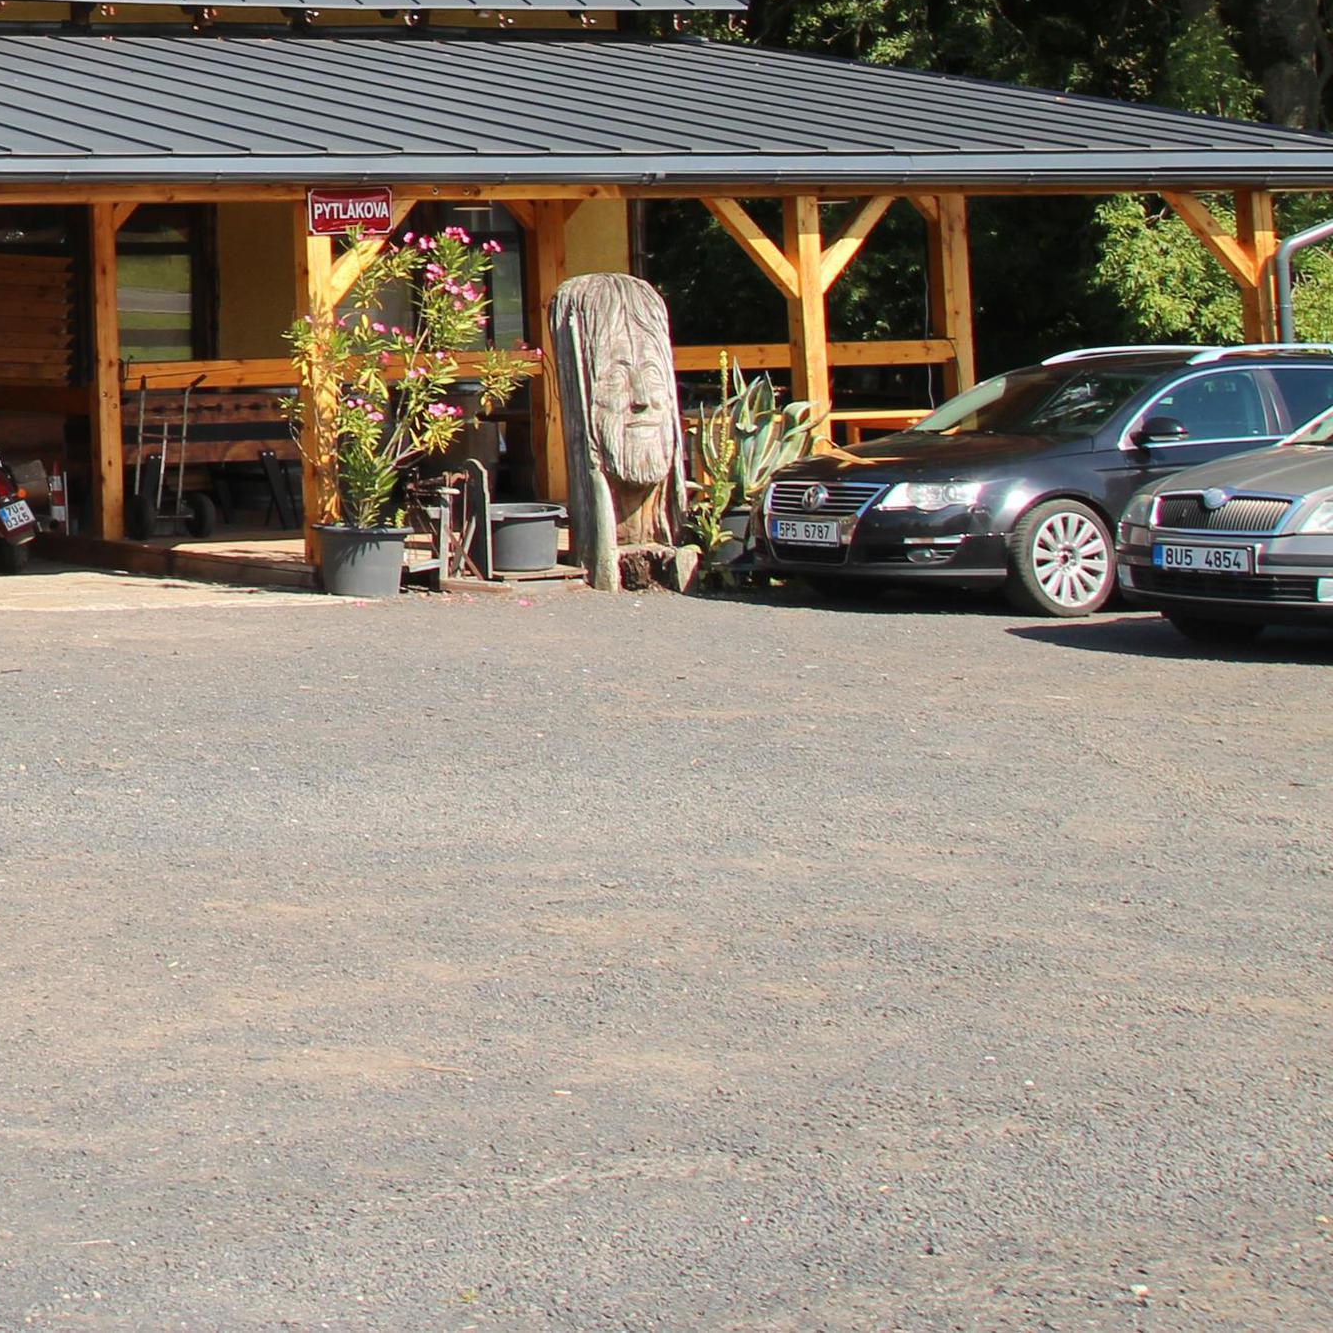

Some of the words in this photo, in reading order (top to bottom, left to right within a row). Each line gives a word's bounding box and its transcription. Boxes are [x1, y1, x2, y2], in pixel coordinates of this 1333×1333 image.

[314, 199, 389, 219] PYTLÁKOVA
[5, 512, 30, 529] 0345
[779, 522, 797, 537] 5P5
[804, 524, 830, 539] 6787
[1165, 547, 1193, 566] 8U5
[1205, 550, 1241, 569] 4854
